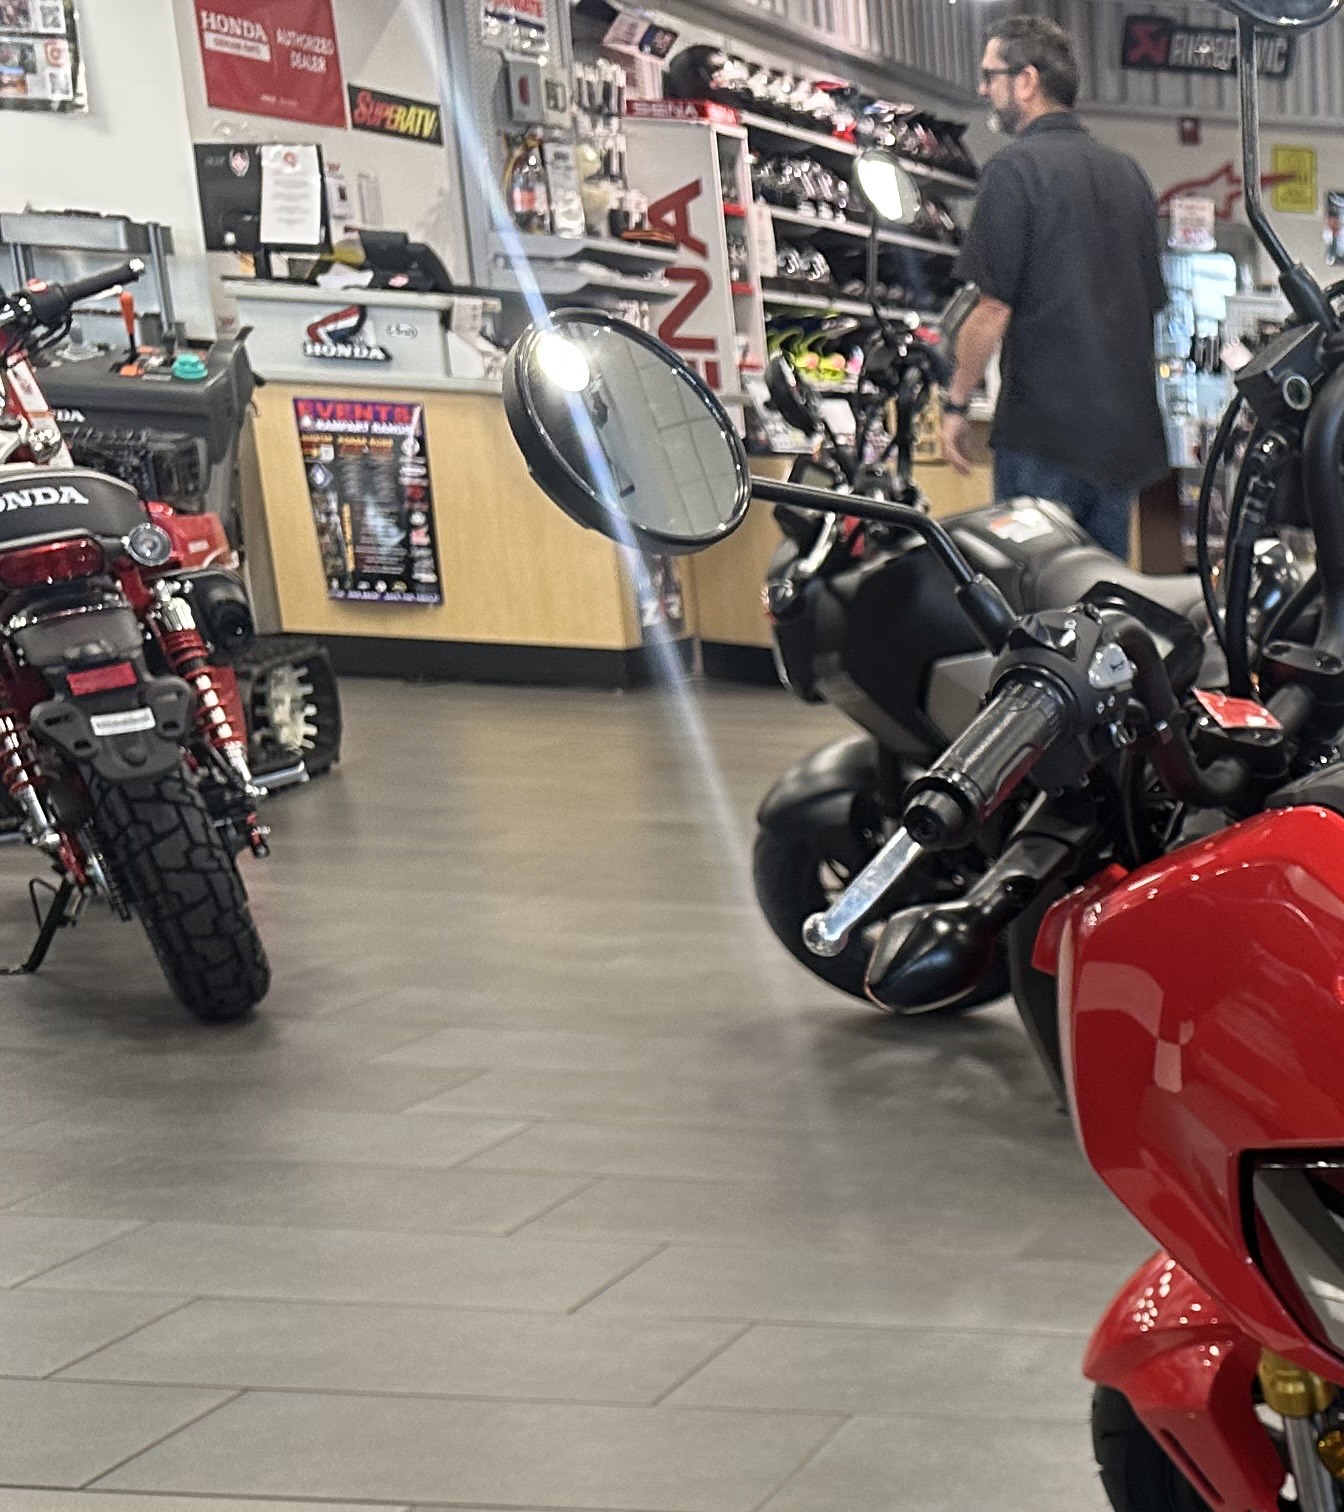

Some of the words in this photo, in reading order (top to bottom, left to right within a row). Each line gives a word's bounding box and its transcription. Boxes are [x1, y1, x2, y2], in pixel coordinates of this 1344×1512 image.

[201, 10, 269, 43] HONDA
[276, 27, 335, 56] AUTHORIZED
[304, 341, 387, 361] HONDA
[0, 486, 89, 513] NDA
